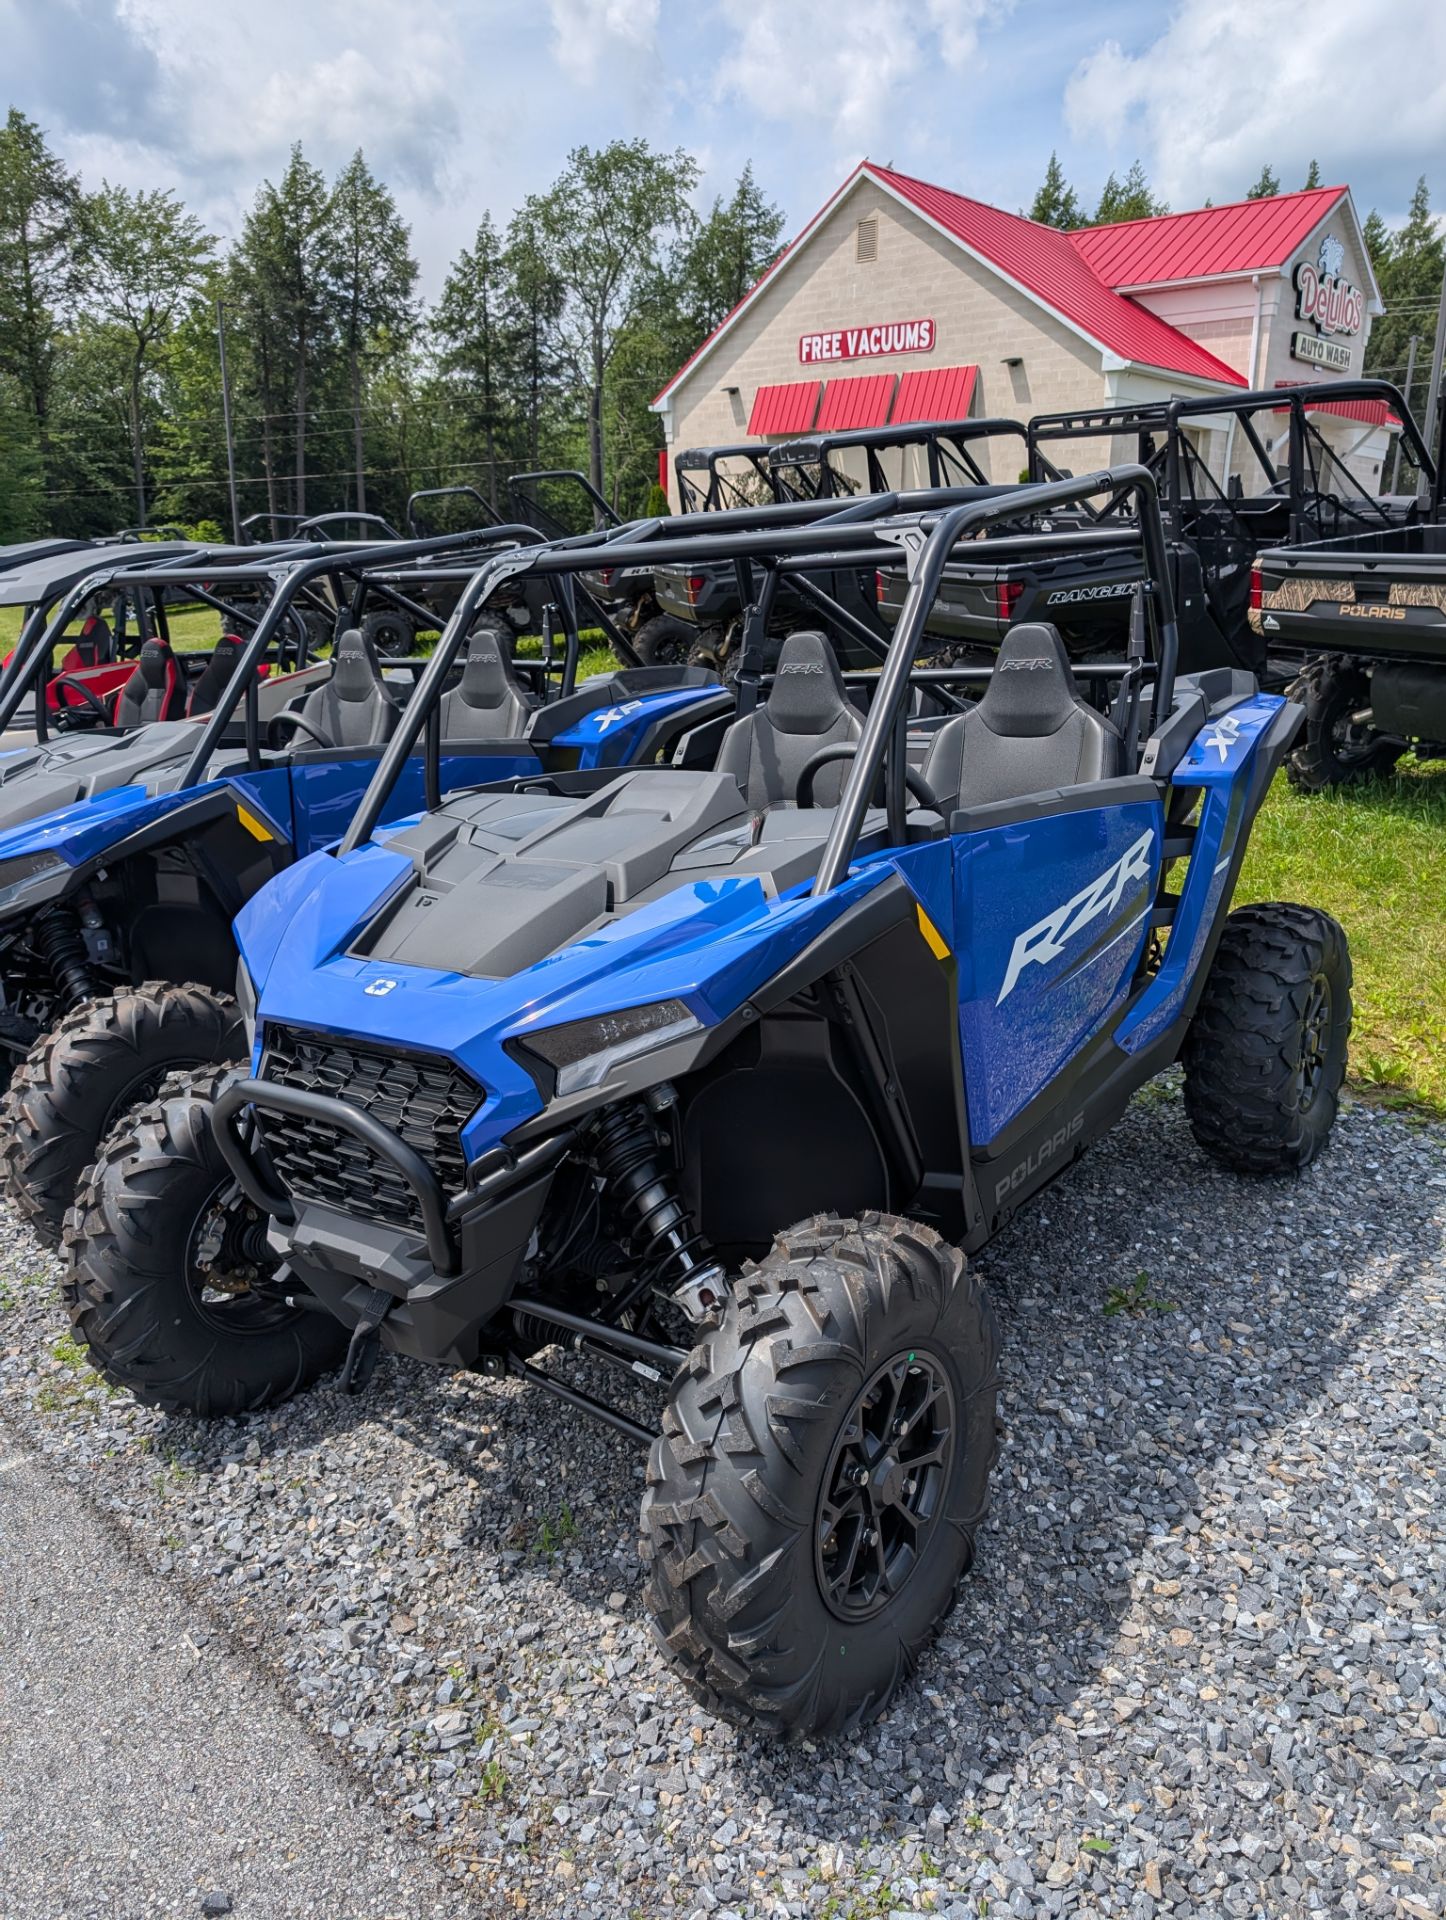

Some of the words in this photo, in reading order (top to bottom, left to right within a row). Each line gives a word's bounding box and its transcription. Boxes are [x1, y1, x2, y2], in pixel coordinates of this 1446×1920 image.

[802, 333, 842, 361] FREE
[847, 322, 930, 355] VACUUMS
[1300, 337, 1324, 359] AUTO
[1326, 345, 1351, 367] WASH
[1047, 582, 1138, 605] RANGER
[1339, 605, 1406, 620] POLARIS
[780, 663, 824, 675] RZR
[1000, 658, 1053, 671] RZR
[592, 700, 643, 733] XP
[1205, 716, 1240, 764] XP
[995, 828, 1154, 1007] RZR
[995, 1110, 1085, 1206] POLARIS
